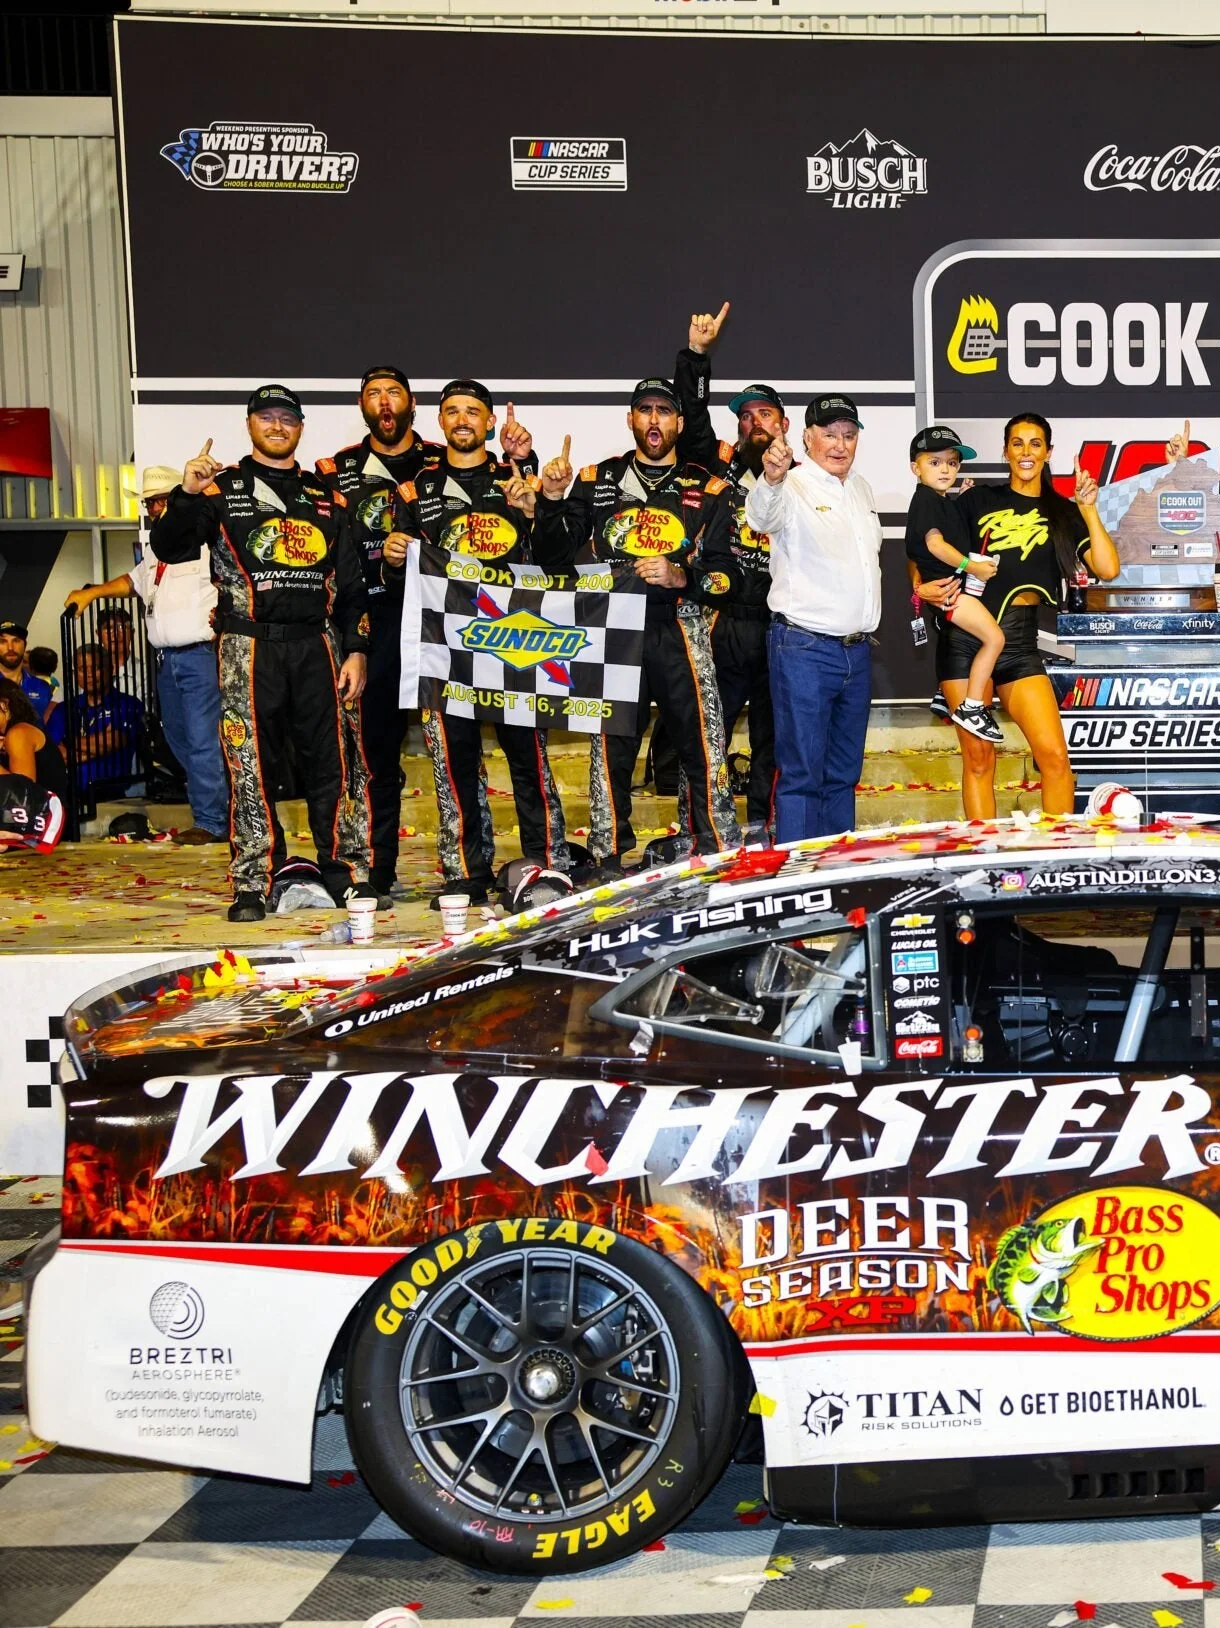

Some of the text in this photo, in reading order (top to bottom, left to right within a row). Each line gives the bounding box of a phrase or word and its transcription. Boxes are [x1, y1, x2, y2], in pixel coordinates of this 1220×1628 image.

[202, 133, 323, 153] WHO'S YOUR
[548, 142, 609, 158] NASCAR
[225, 154, 354, 182] DRIVER?
[528, 164, 611, 179] CUP SERIES
[806, 156, 928, 194] BUSCH
[832, 193, 902, 208] LIGHT
[1007, 301, 1210, 387] COOK
[1167, 497, 1202, 506] COOK OUT
[466, 513, 500, 528] Bass
[635, 509, 670, 525] Bass
[1168, 510, 1197, 520] 400
[279, 520, 313, 536] Bass
[467, 527, 493, 541] Pro
[635, 522, 661, 537] Pro
[281, 534, 306, 549] Pro
[468, 539, 508, 555] Shops
[634, 534, 674, 552] Shops
[285, 546, 318, 565] Shops
[251, 570, 324, 580] WINCHESTER
[445, 560, 614, 591] COOK OUT 400
[1089, 621, 1115, 631] BUSCH
[1133, 619, 1163, 630] Coca-Cola
[1182, 618, 1215, 630] xfinity
[464, 621, 583, 656] SUNOCO
[442, 685, 613, 719] AUGUST 16, 2025
[702, 667, 722, 759] WINCHESTER
[1068, 721, 1127, 747] CUP
[12, 807, 28, 823] 3
[34, 816, 45, 831] 3
[1028, 868, 1217, 888] AUSTINDILLON3
[568, 888, 833, 958] Huk Fishing
[891, 929, 936, 937] CHEVROLET
[891, 939, 937, 950] LUCAS OIL
[914, 976, 940, 992] ptc
[356, 965, 514, 1027] United Rentals
[898, 1040, 939, 1055] Coca-Cola
[143, 1070, 1211, 1187] WINCHESTER
[1090, 1196, 1184, 1238] Bass
[737, 1196, 972, 1268] DEER
[1094, 1237, 1165, 1275] Pro
[742, 1259, 970, 1308] SEASON
[1094, 1274, 1211, 1321] Shops
[806, 1295, 916, 1332] XP
[130, 1347, 234, 1365] BREZTRI
[132, 1369, 234, 1381] AEROSPHERE
[105, 1389, 265, 1403] (budesonide, glycopyrrolate,
[856, 1388, 984, 1418] TITAN
[1021, 1387, 1203, 1413] GET BIOETHANOL
[116, 1406, 257, 1421] and formoterol fumarate)
[138, 1425, 239, 1437] Inhalation Aerosol
[861, 1417, 983, 1431] RISK SOLUTIONS
[532, 1488, 656, 1559] EAGLE
